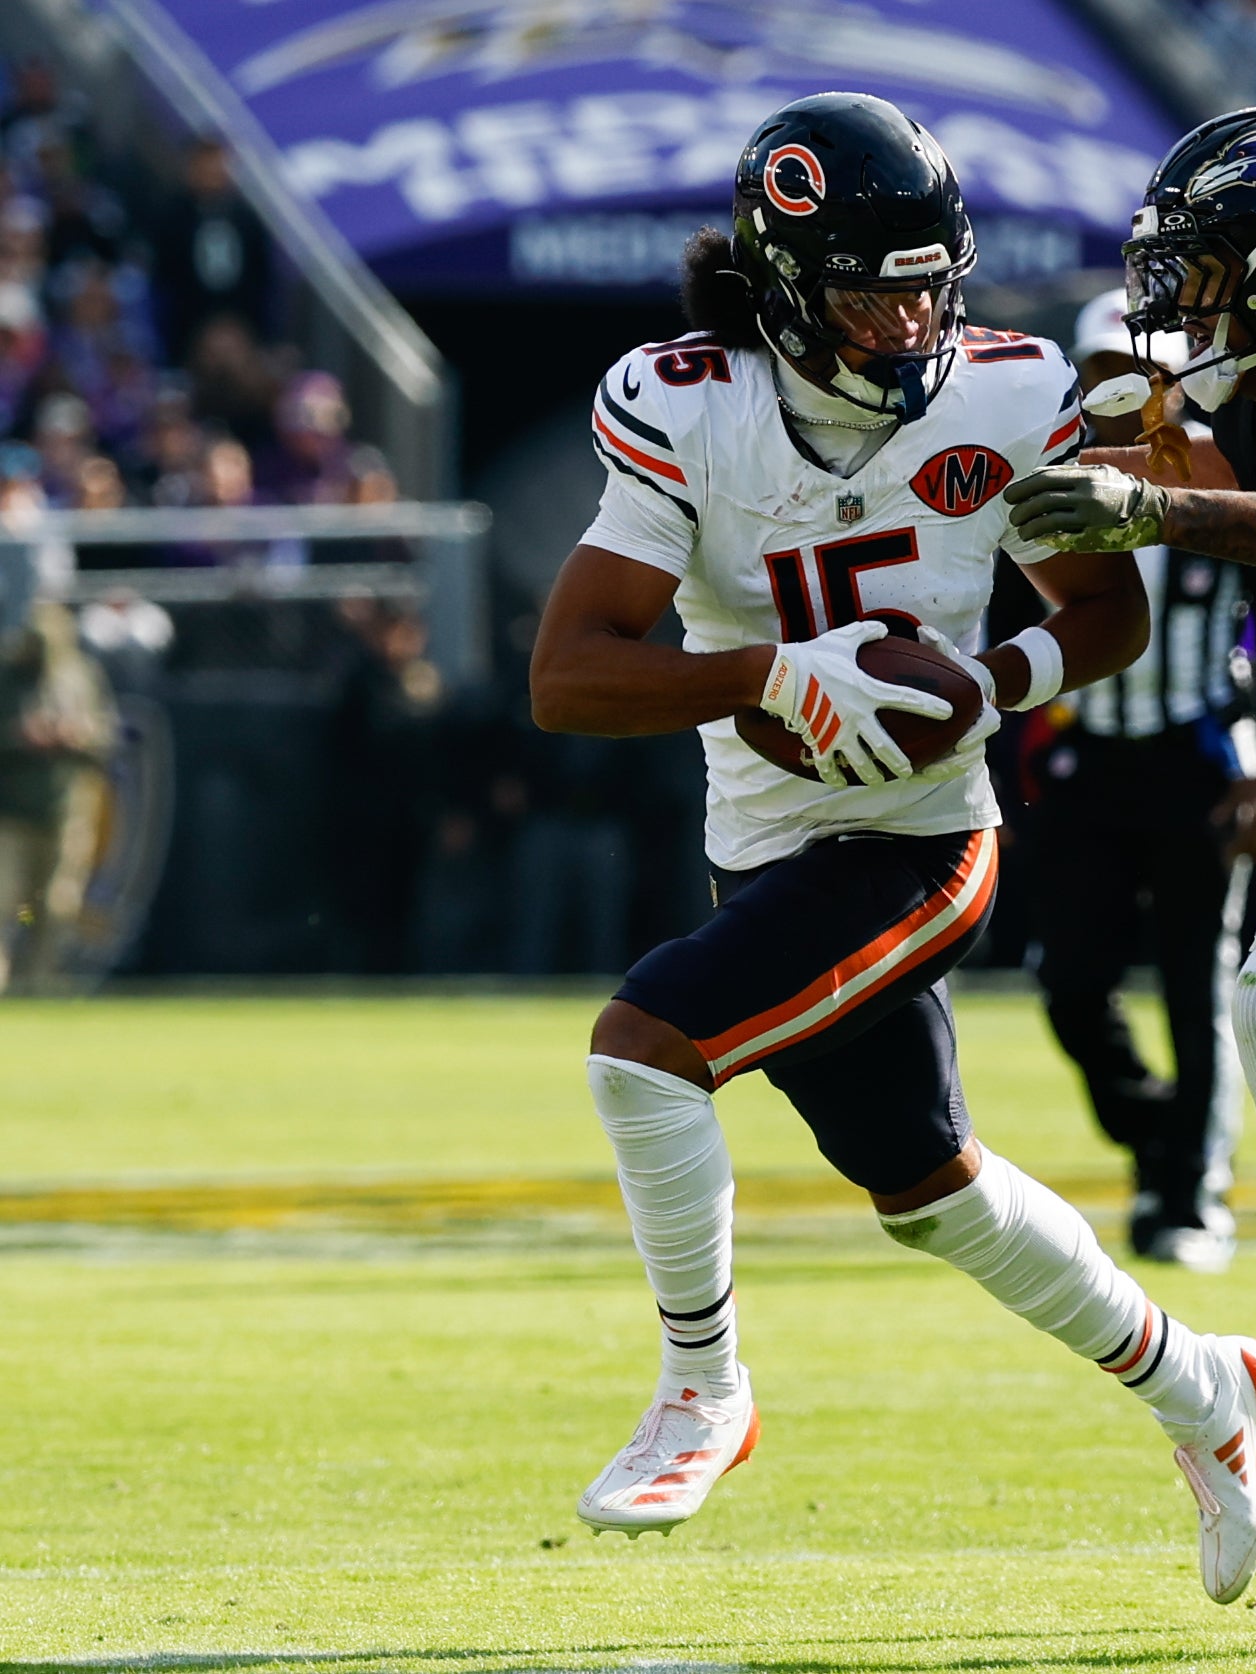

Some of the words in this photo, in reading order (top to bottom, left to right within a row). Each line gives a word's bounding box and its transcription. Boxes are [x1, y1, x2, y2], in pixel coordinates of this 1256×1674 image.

[763, 143, 826, 216] C
[1160, 223, 1192, 233] OAKLEY
[826, 263, 864, 273] OAKLEY
[895, 252, 942, 267] BEARS
[640, 335, 732, 387] 15
[841, 506, 861, 521] NFL
[764, 526, 920, 644] 15
[768, 661, 788, 701] ADIZERO
